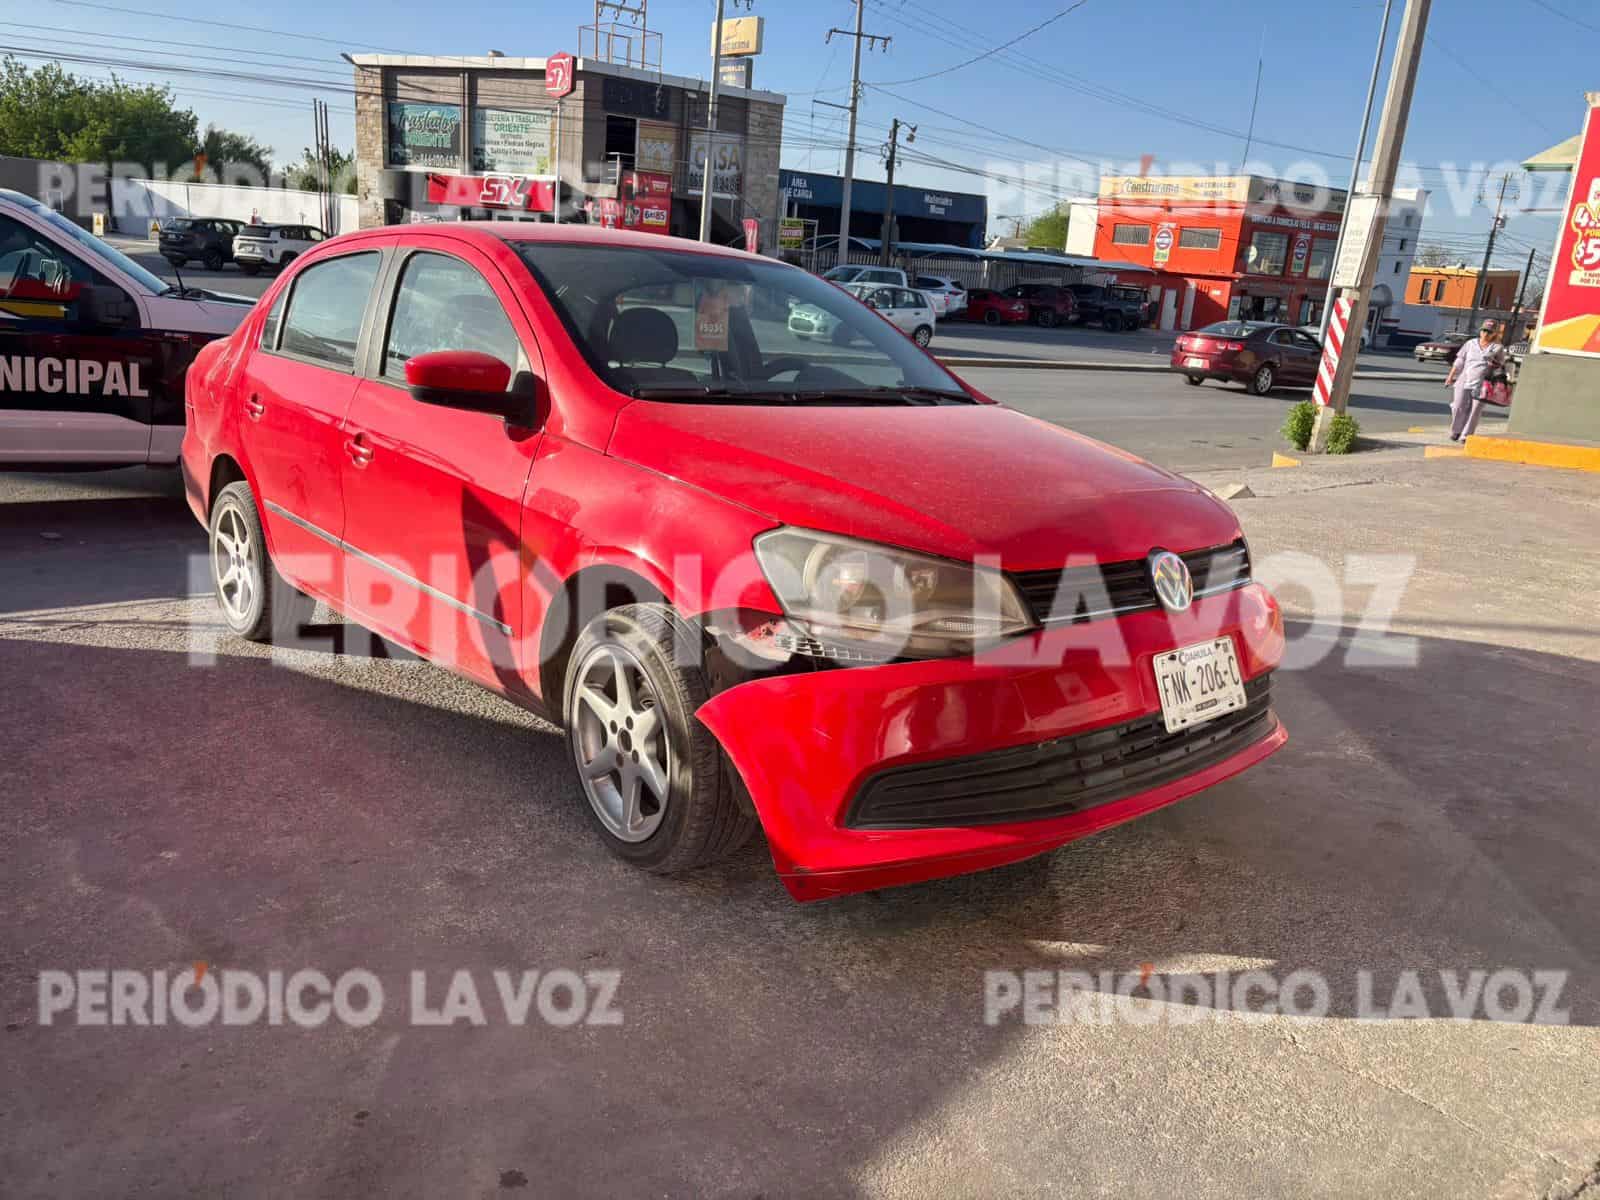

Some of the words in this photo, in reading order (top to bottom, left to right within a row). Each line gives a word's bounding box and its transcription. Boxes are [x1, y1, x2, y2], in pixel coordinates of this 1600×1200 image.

[495, 122, 530, 134] ORIENTE
[480, 174, 527, 206] SIX
[1124, 180, 1180, 194] Construrama
